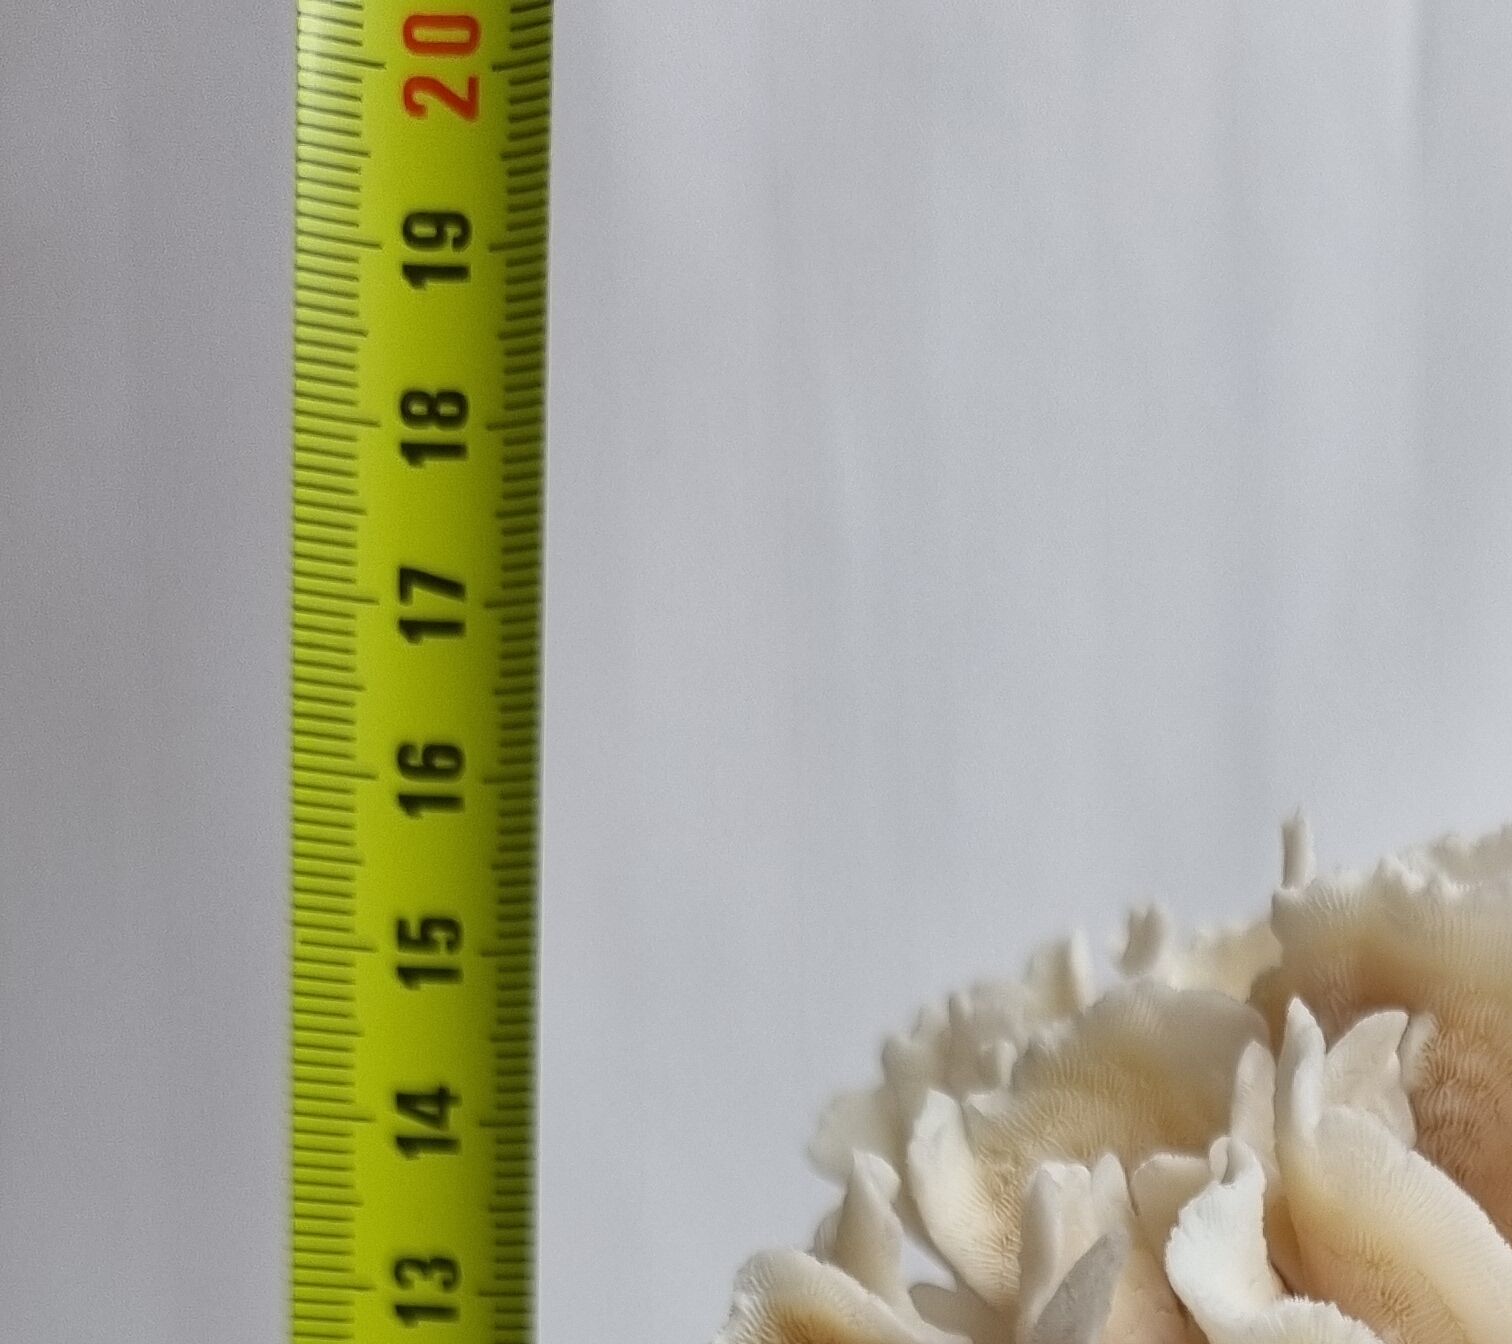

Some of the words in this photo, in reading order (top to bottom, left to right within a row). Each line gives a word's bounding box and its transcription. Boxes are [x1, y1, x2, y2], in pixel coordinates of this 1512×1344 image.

[403, 14, 481, 122] 20
[402, 210, 472, 290] 19
[400, 389, 468, 467] 18
[397, 566, 466, 645] 17
[396, 742, 465, 819] 16
[395, 917, 464, 990] 15
[395, 1084, 462, 1159] 14
[394, 1256, 461, 1327] 13
